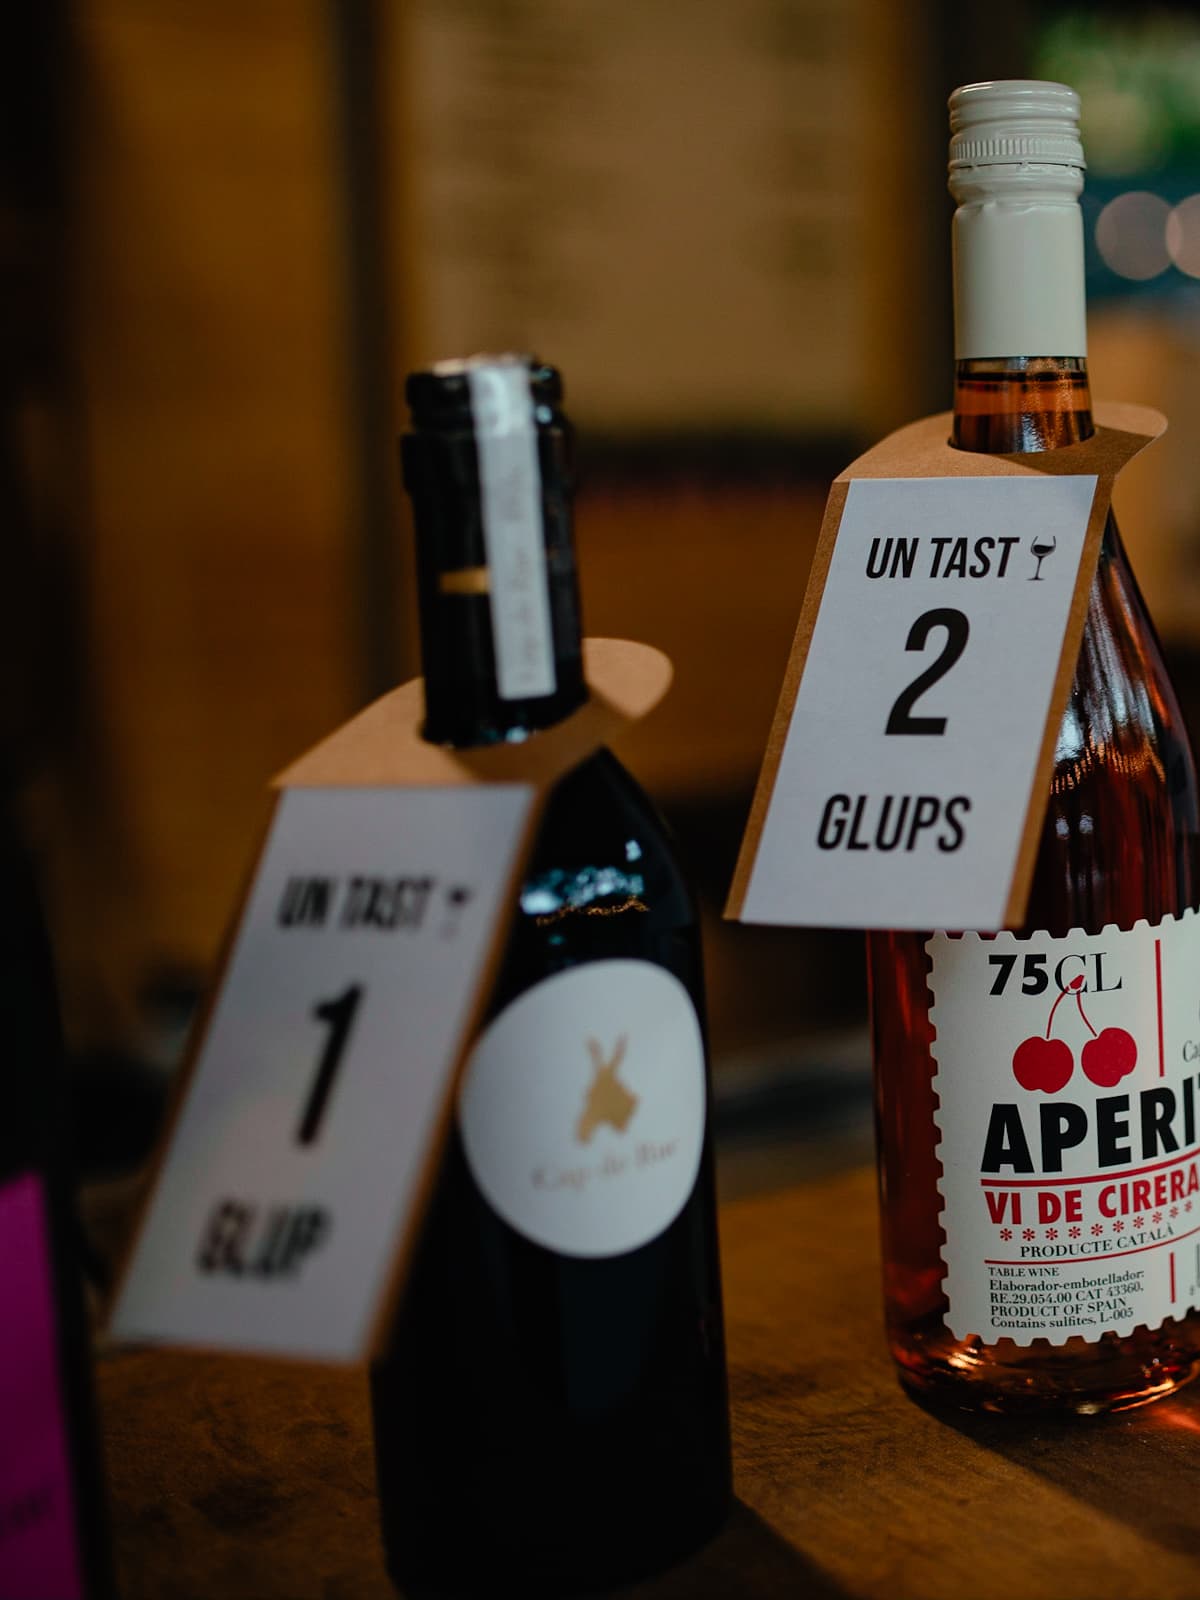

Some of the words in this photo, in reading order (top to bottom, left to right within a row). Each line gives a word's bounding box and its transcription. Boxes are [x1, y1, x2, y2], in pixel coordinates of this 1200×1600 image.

[865, 536, 919, 579] UN
[929, 536, 1020, 579] TAST
[884, 607, 970, 736] 2
[816, 793, 972, 853] GLUPS
[278, 876, 338, 931] UN
[341, 876, 436, 932] TAST
[987, 951, 1123, 997] 75CL
[295, 982, 365, 1148] 1
[984, 1191, 1022, 1225] VI
[1037, 1189, 1083, 1225] DE
[1098, 1162, 1200, 1219] CIRERA
[198, 1200, 331, 1282] GLUP
[1020, 1238, 1113, 1259] PRODUCTE
[988, 1266, 1026, 1278] TABLE
[1028, 1266, 1060, 1278] WINE
[1075, 1288, 1104, 1302] CAT
[991, 1304, 1060, 1318] PRODUCT
[1063, 1302, 1084, 1316] OF
[1087, 1296, 1128, 1314] SPAIN
[991, 1315, 1048, 1329] Contains
[1049, 1314, 1098, 1329] sulfites,
[1100, 1307, 1135, 1324] L-005
